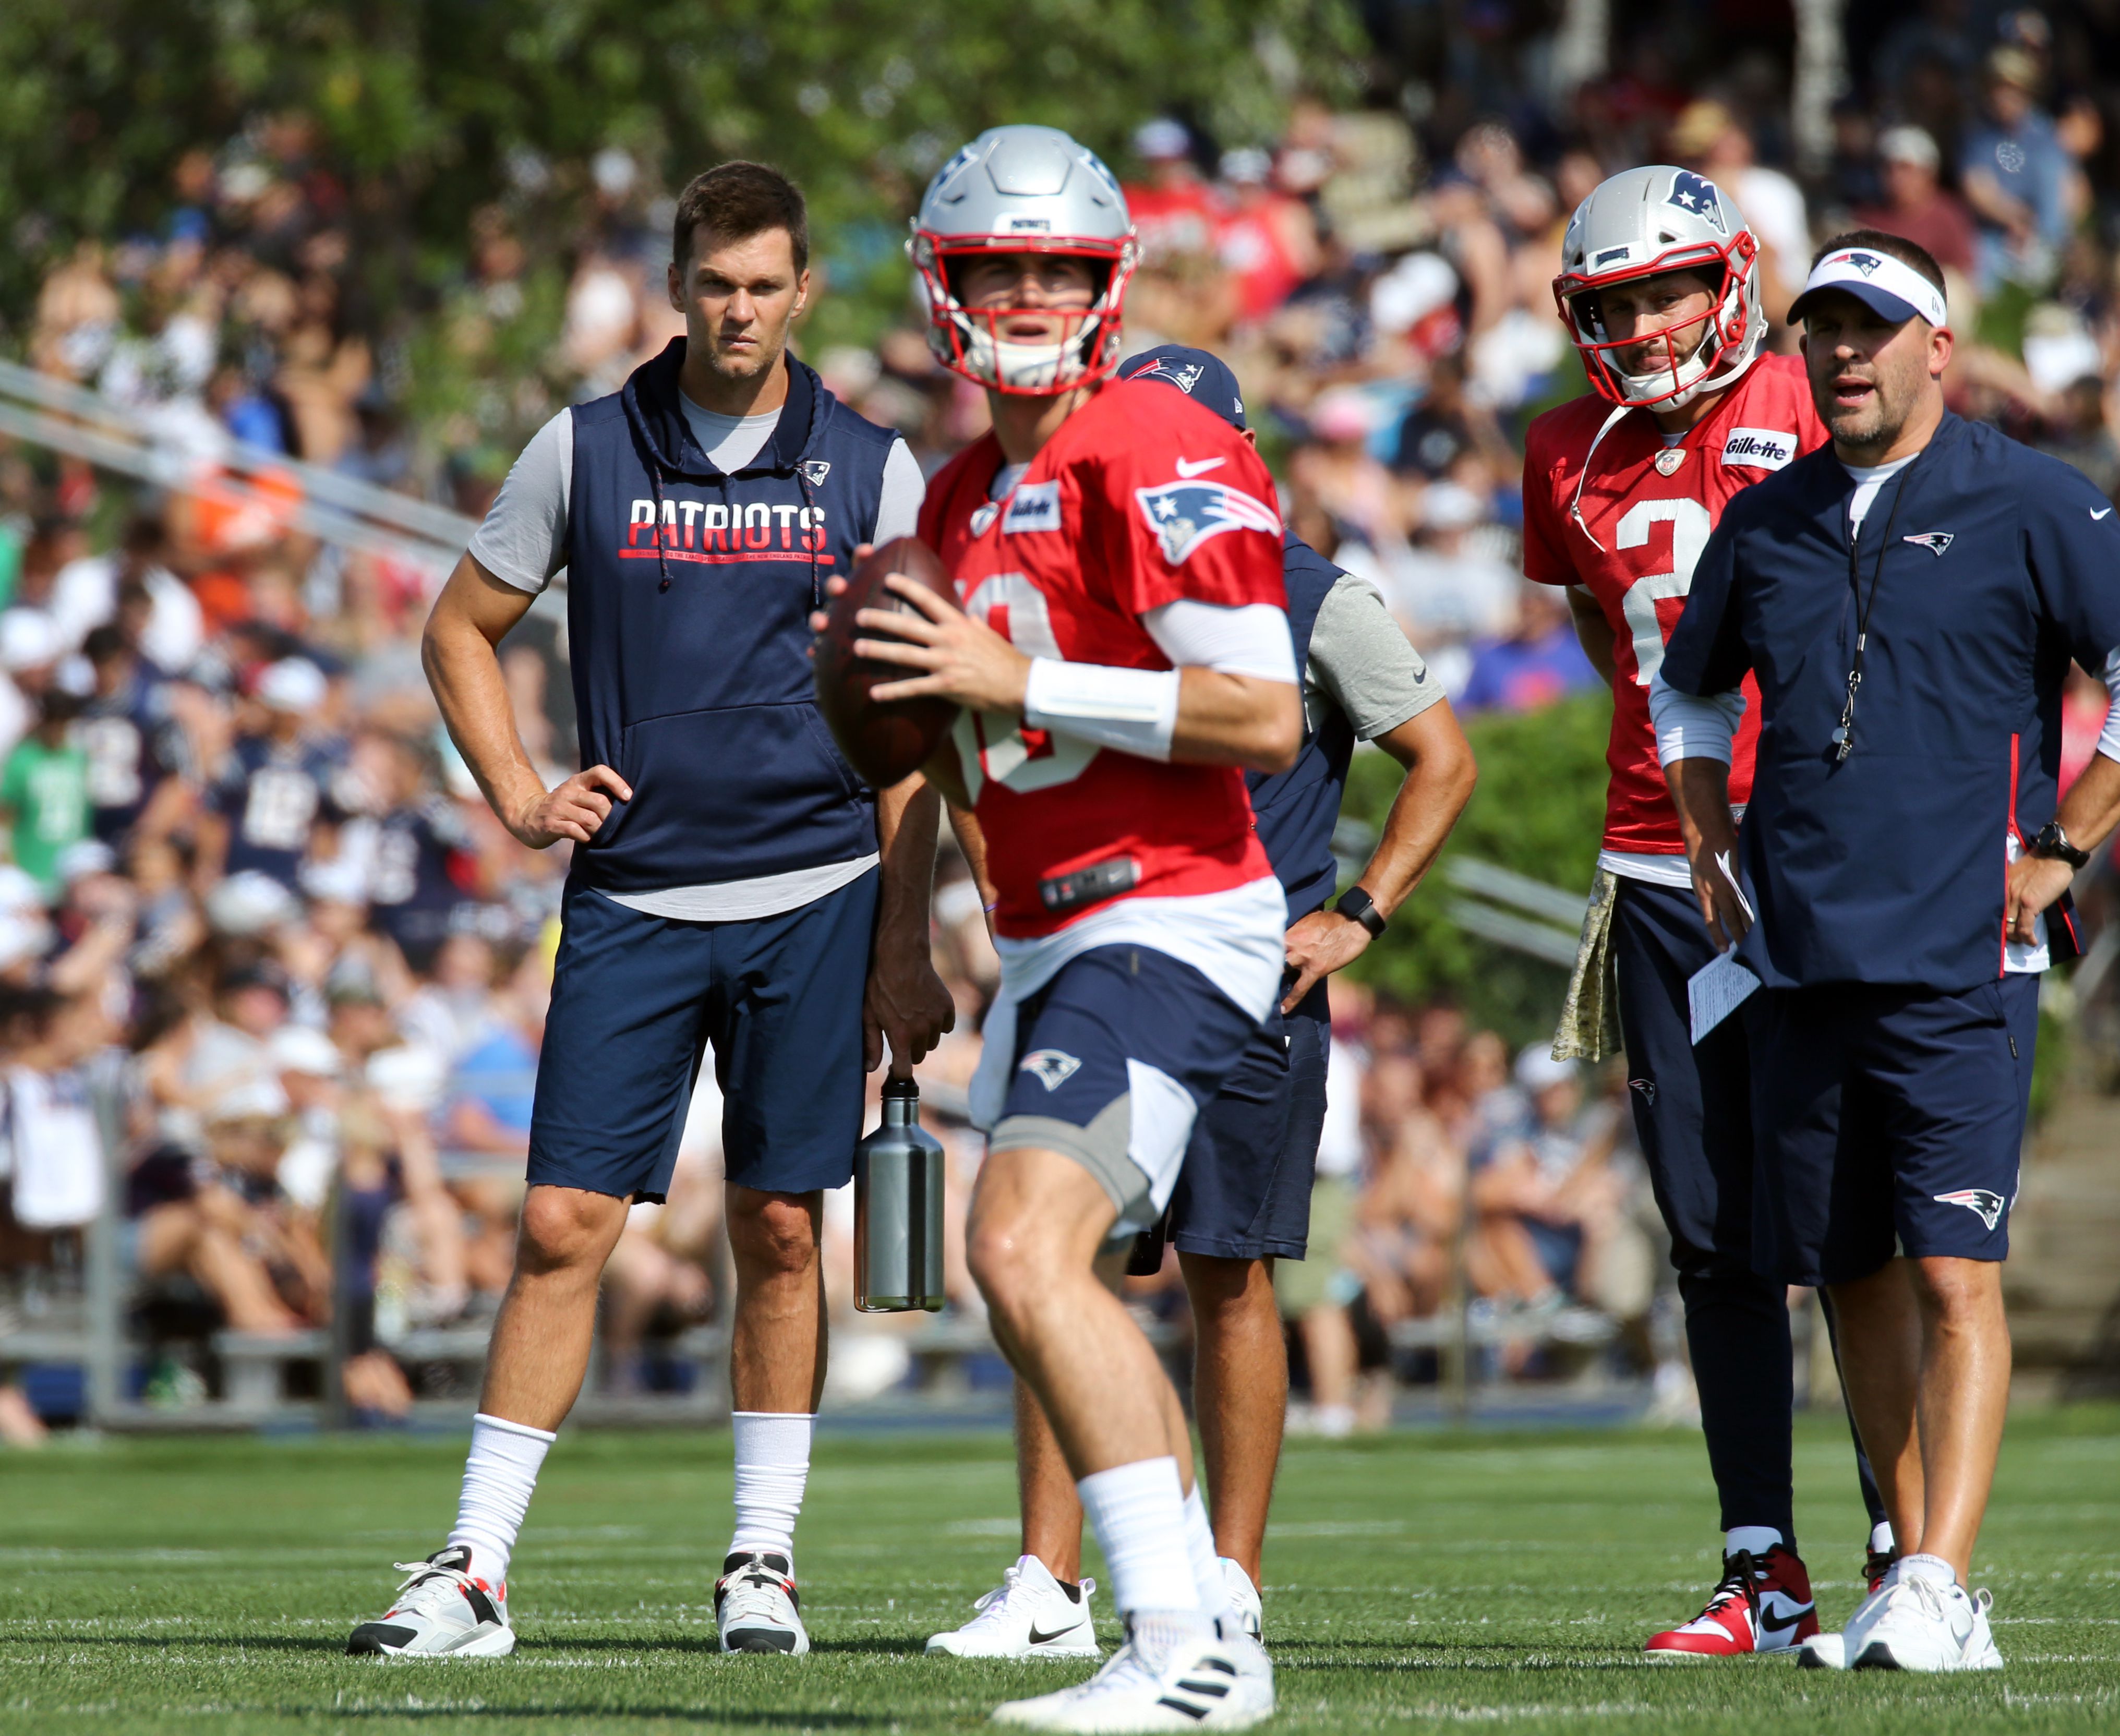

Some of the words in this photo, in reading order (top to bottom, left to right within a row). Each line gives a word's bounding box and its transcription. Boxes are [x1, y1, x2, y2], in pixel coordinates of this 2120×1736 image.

[1726, 437, 1787, 461] Gillette
[628, 499, 827, 552] PATRIOTS
[1616, 497, 1712, 685] 2
